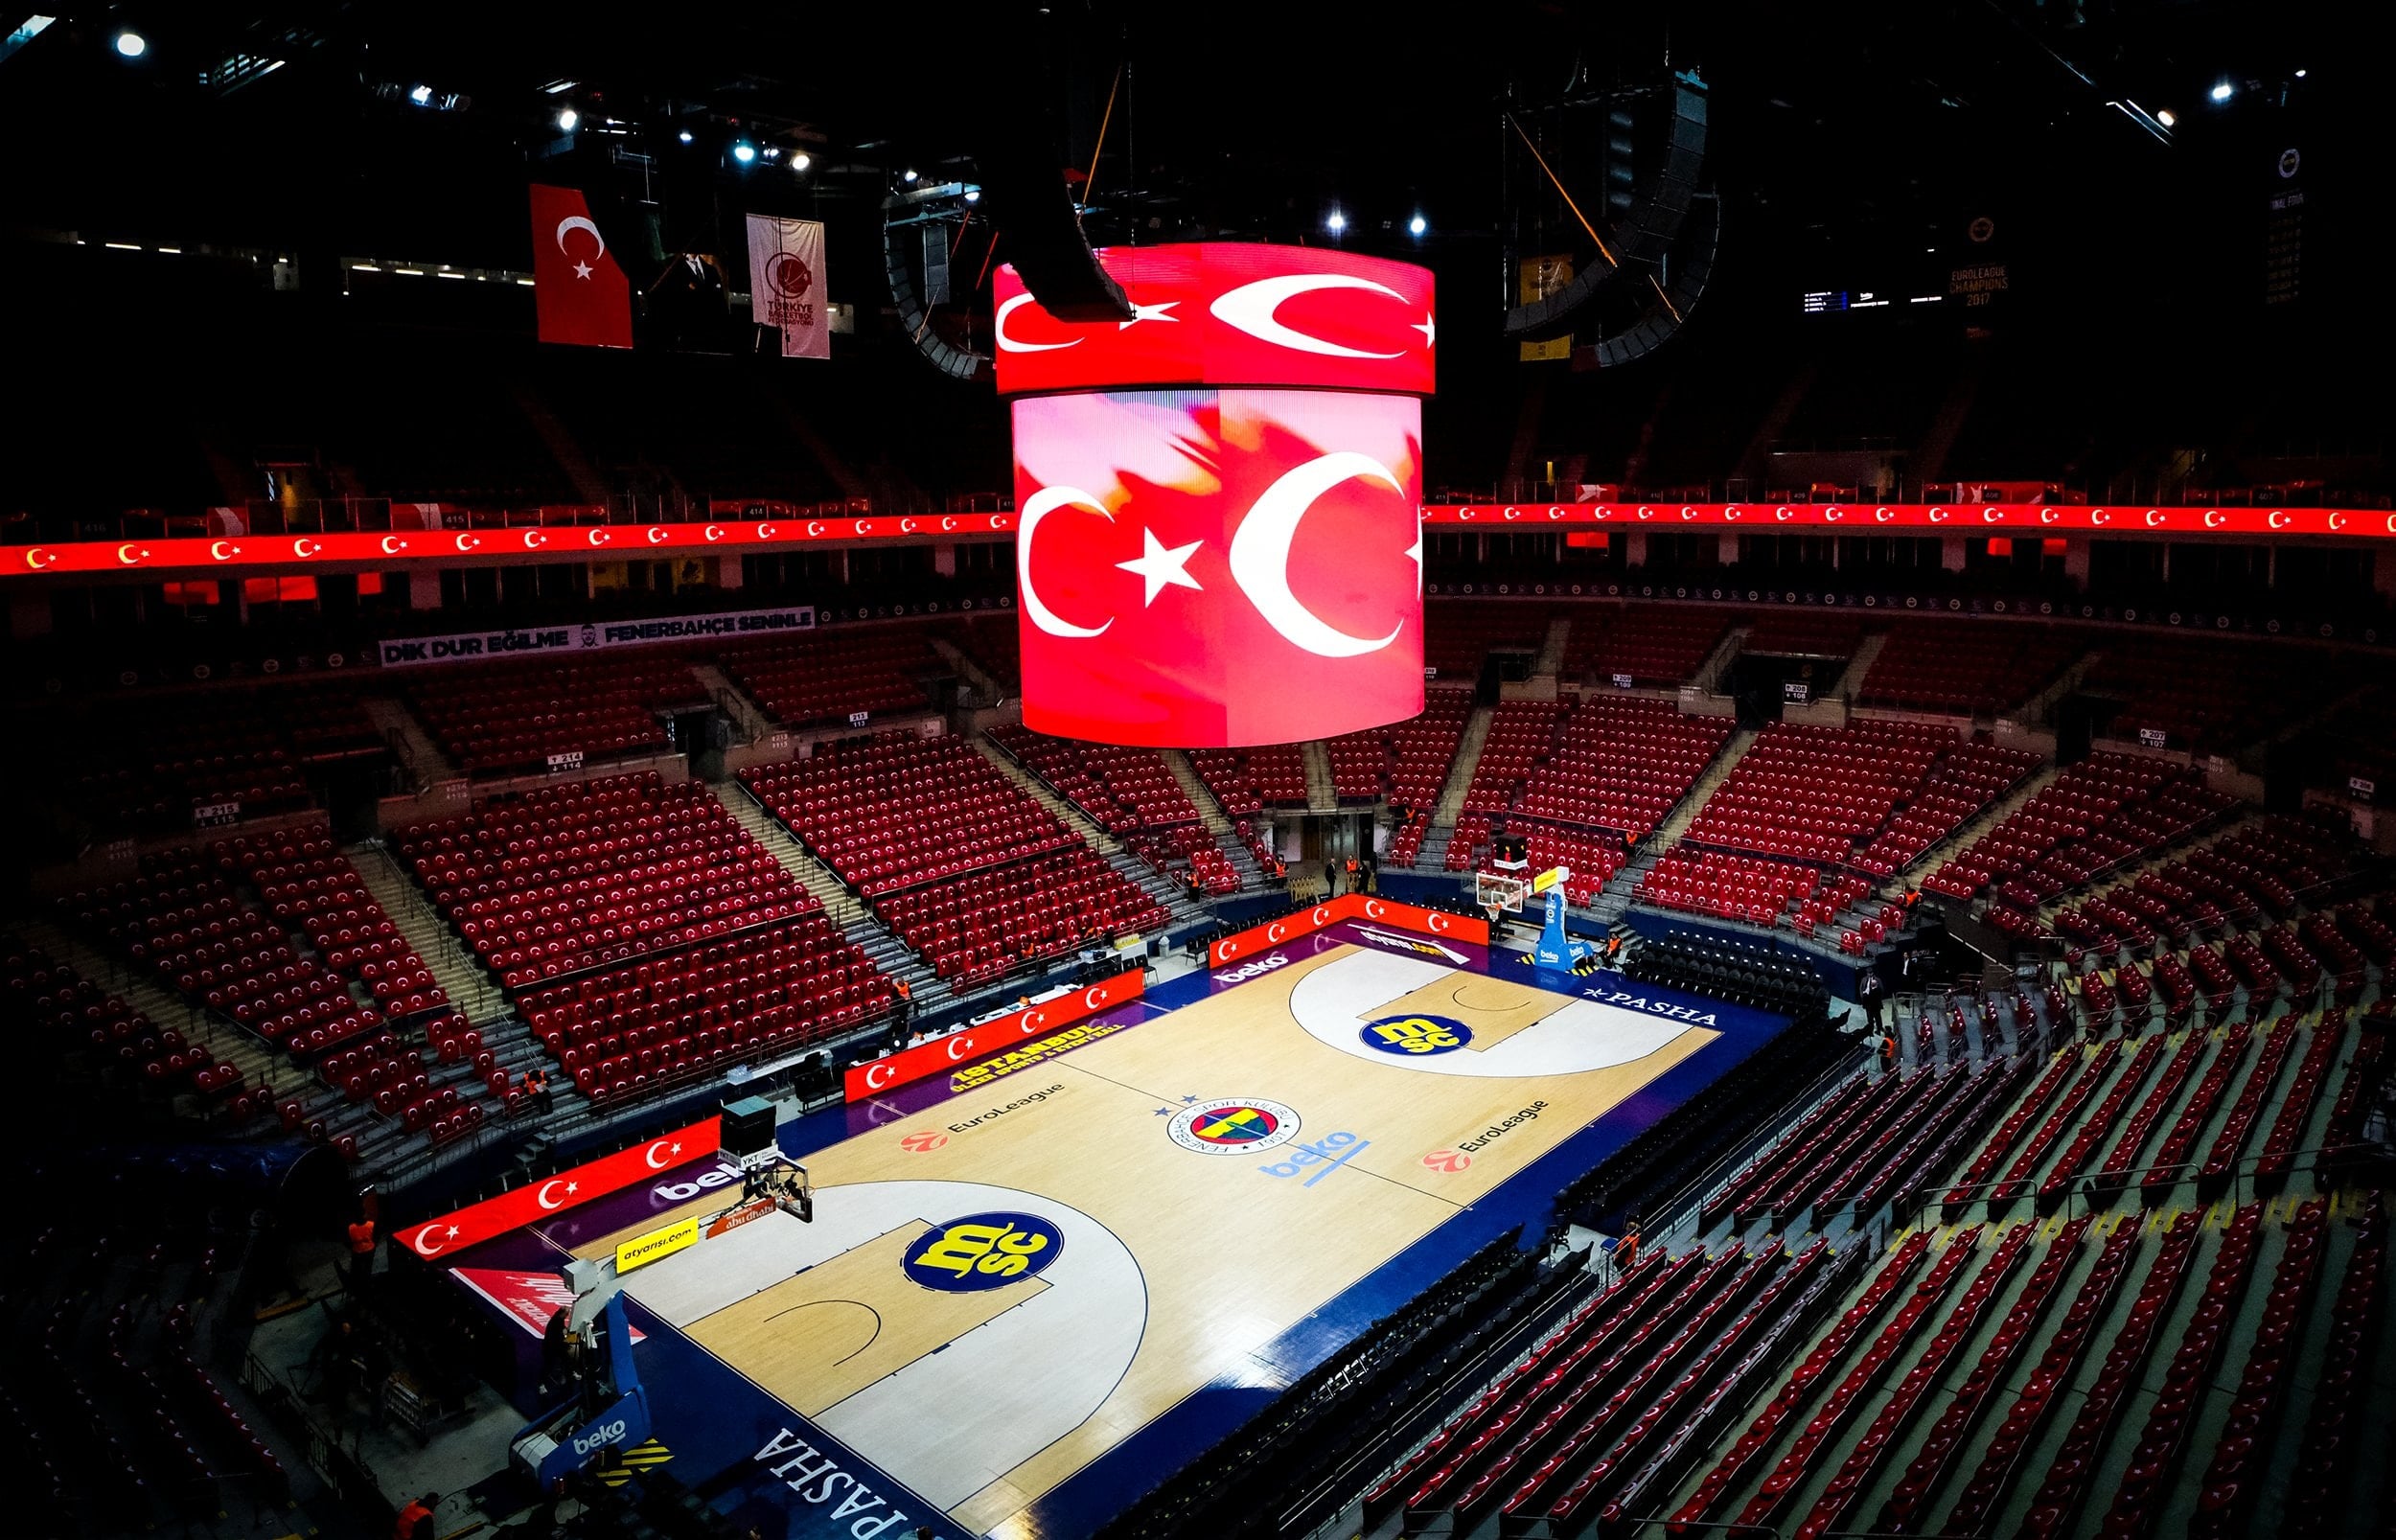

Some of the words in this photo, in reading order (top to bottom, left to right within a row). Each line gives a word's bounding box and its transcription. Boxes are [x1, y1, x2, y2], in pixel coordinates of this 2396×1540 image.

[768, 301, 814, 314] TÜRKİYE
[1967, 291, 1992, 307] 2017
[446, 514, 465, 524] 415
[749, 507, 764, 516] 414
[431, 638, 483, 658] DUR
[605, 616, 737, 643] FENERBAHÇE
[562, 753, 580, 762] 214
[212, 804, 234, 816] 215
[214, 814, 236, 824] 115
[1212, 954, 1289, 983] beko
[1605, 991, 1717, 1026] PASHA
[947, 1082, 1067, 1134] EuroLeague
[1197, 1100, 1237, 1119] SPOR
[1459, 1098, 1550, 1154] EuroLeague
[743, 1155, 760, 1165] YKT
[1257, 1132, 1357, 1179] beko
[726, 1213, 748, 1230] abu
[746, 1204, 774, 1222] dhabi
[573, 1419, 626, 1456] beko
[753, 1427, 910, 1540] PASHA
